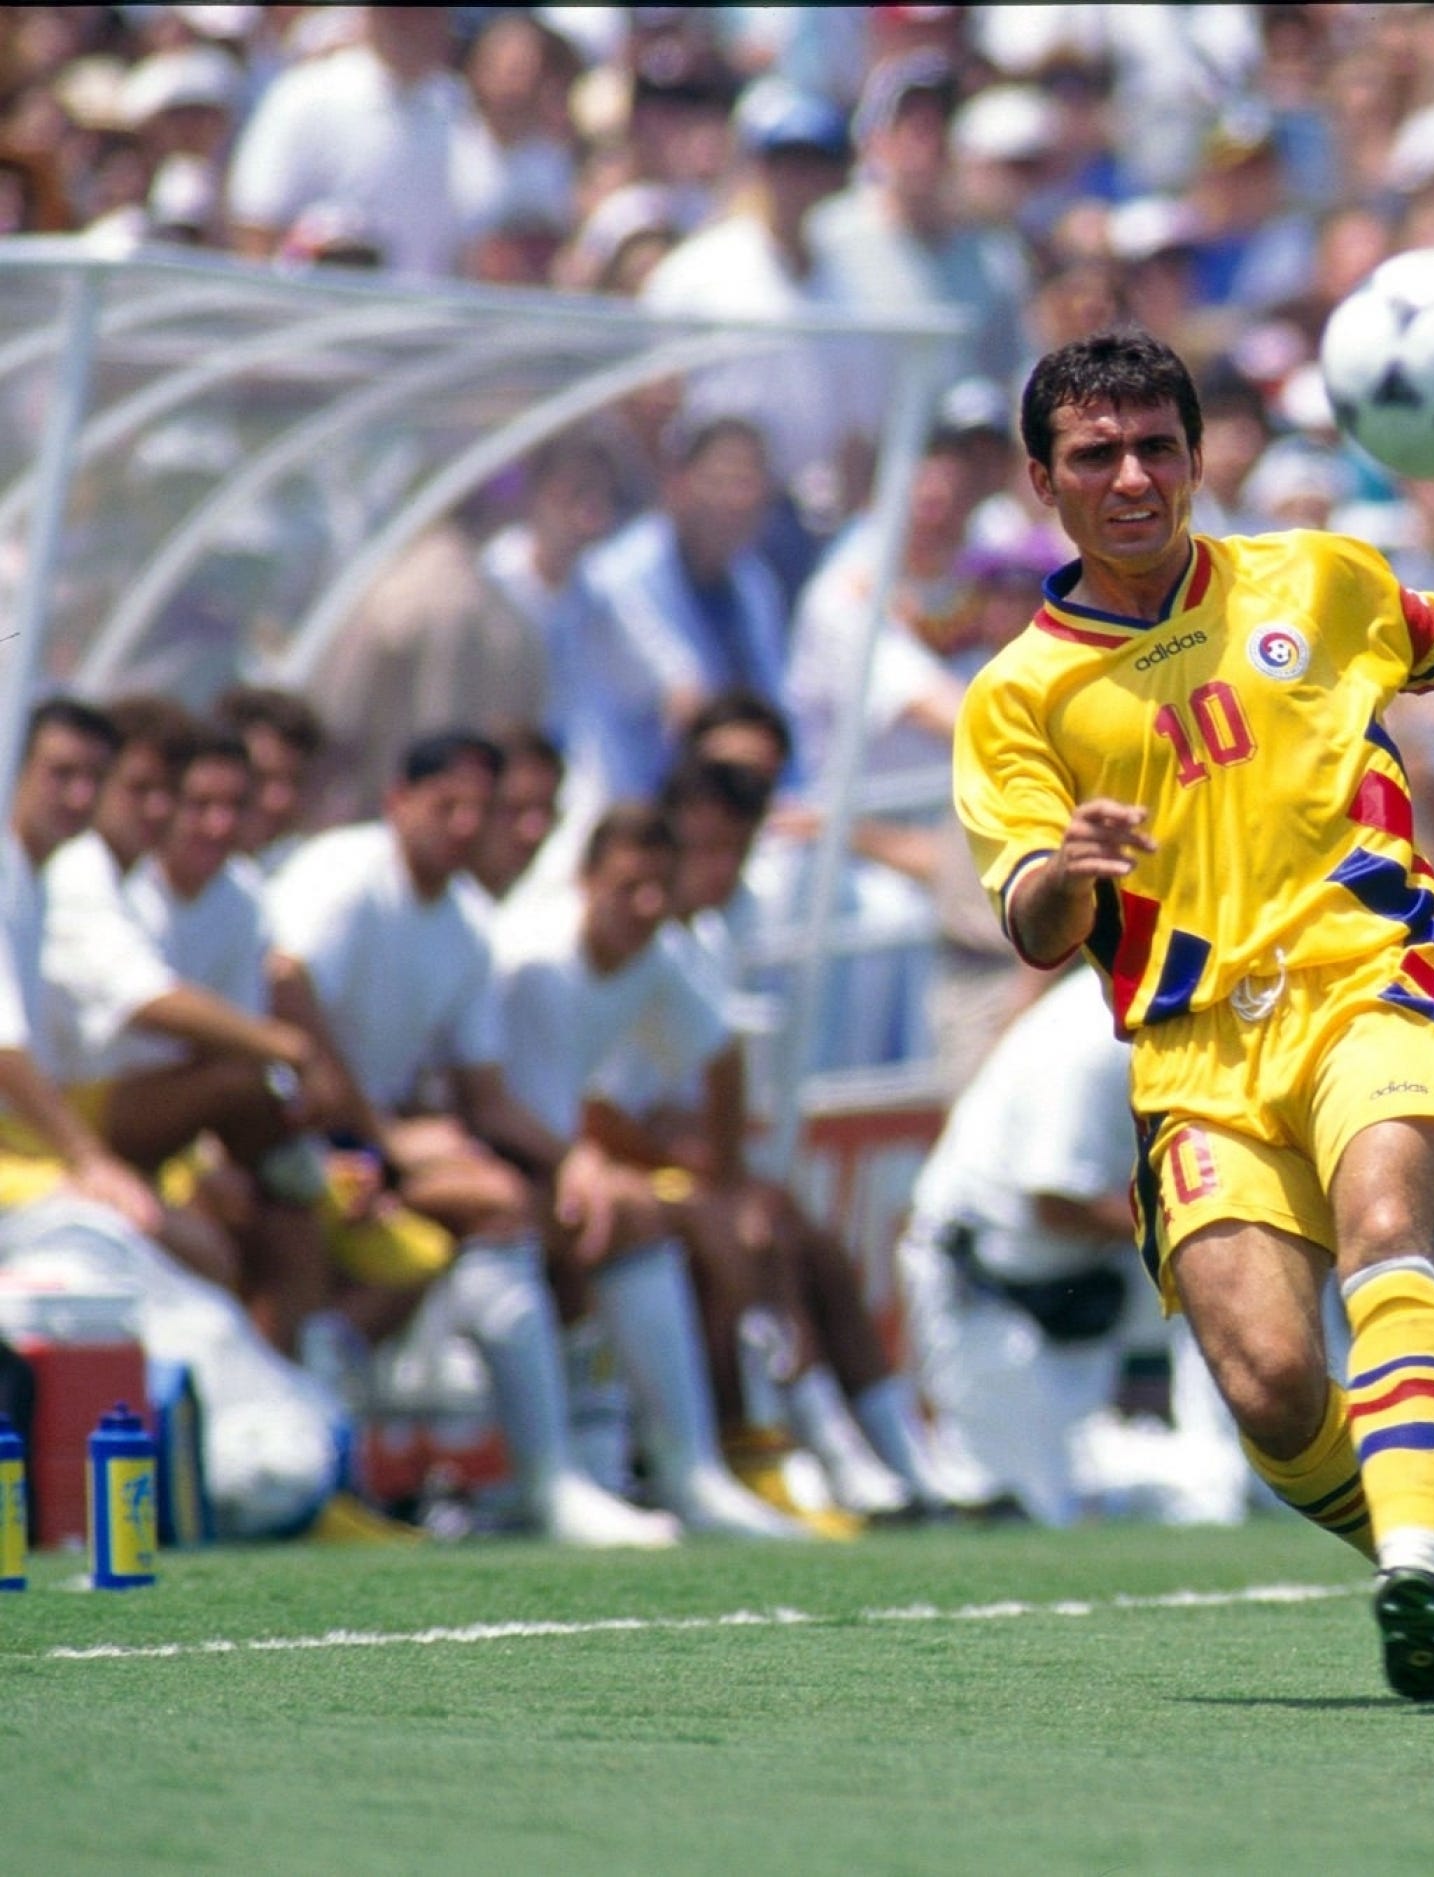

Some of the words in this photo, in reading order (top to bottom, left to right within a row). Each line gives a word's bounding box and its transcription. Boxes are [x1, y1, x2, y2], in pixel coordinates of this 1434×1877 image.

[1134, 630, 1208, 671] adidas
[1154, 680, 1258, 789] 10
[1369, 1080, 1429, 1101] adidas
